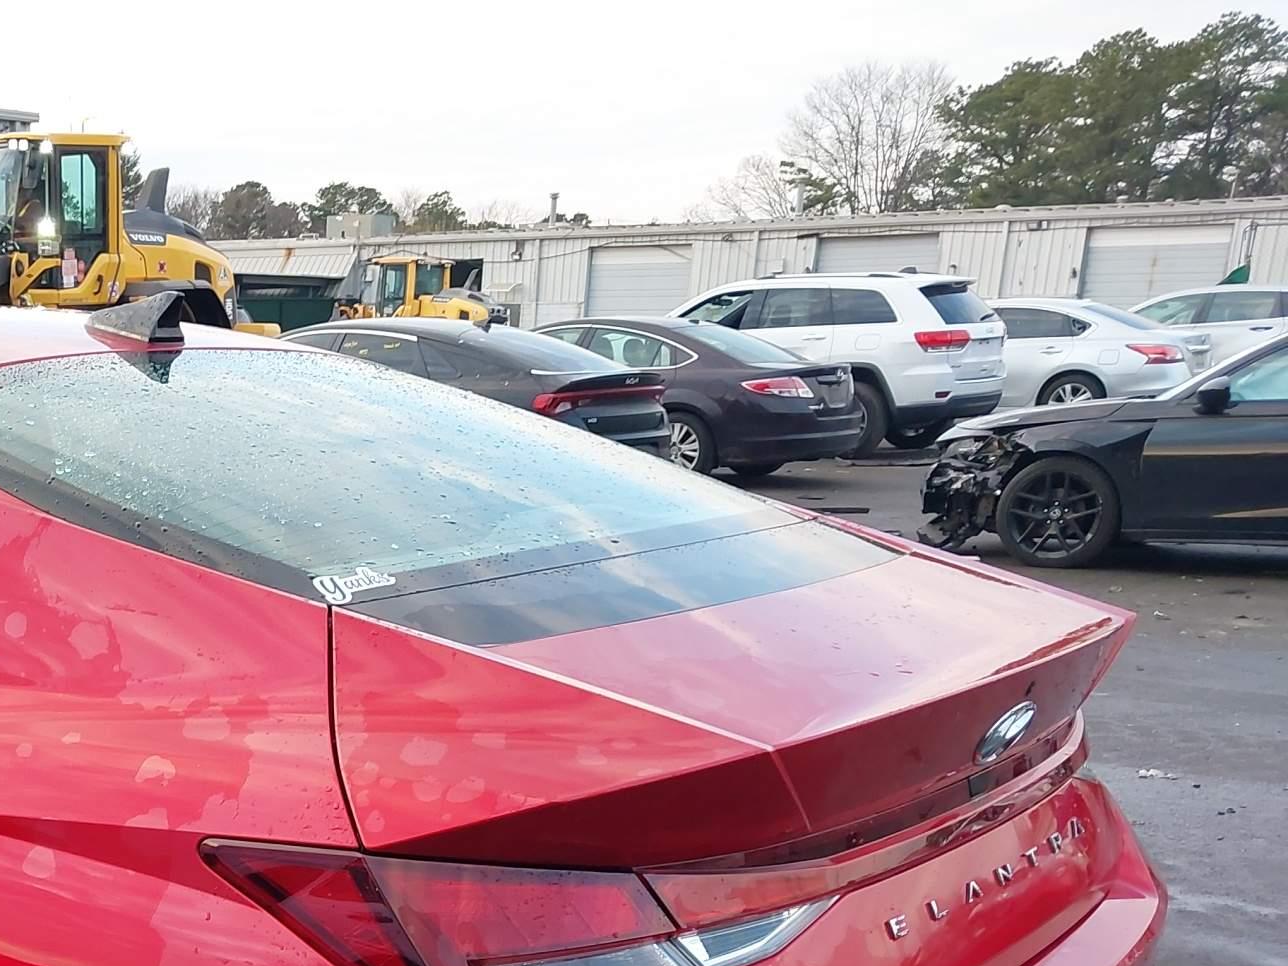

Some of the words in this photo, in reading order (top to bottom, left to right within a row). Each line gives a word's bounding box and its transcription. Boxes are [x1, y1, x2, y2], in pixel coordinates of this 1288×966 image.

[128, 232, 165, 243] VOLVO
[318, 568, 391, 602] Yanks
[884, 815, 1086, 941] ELANTRA
